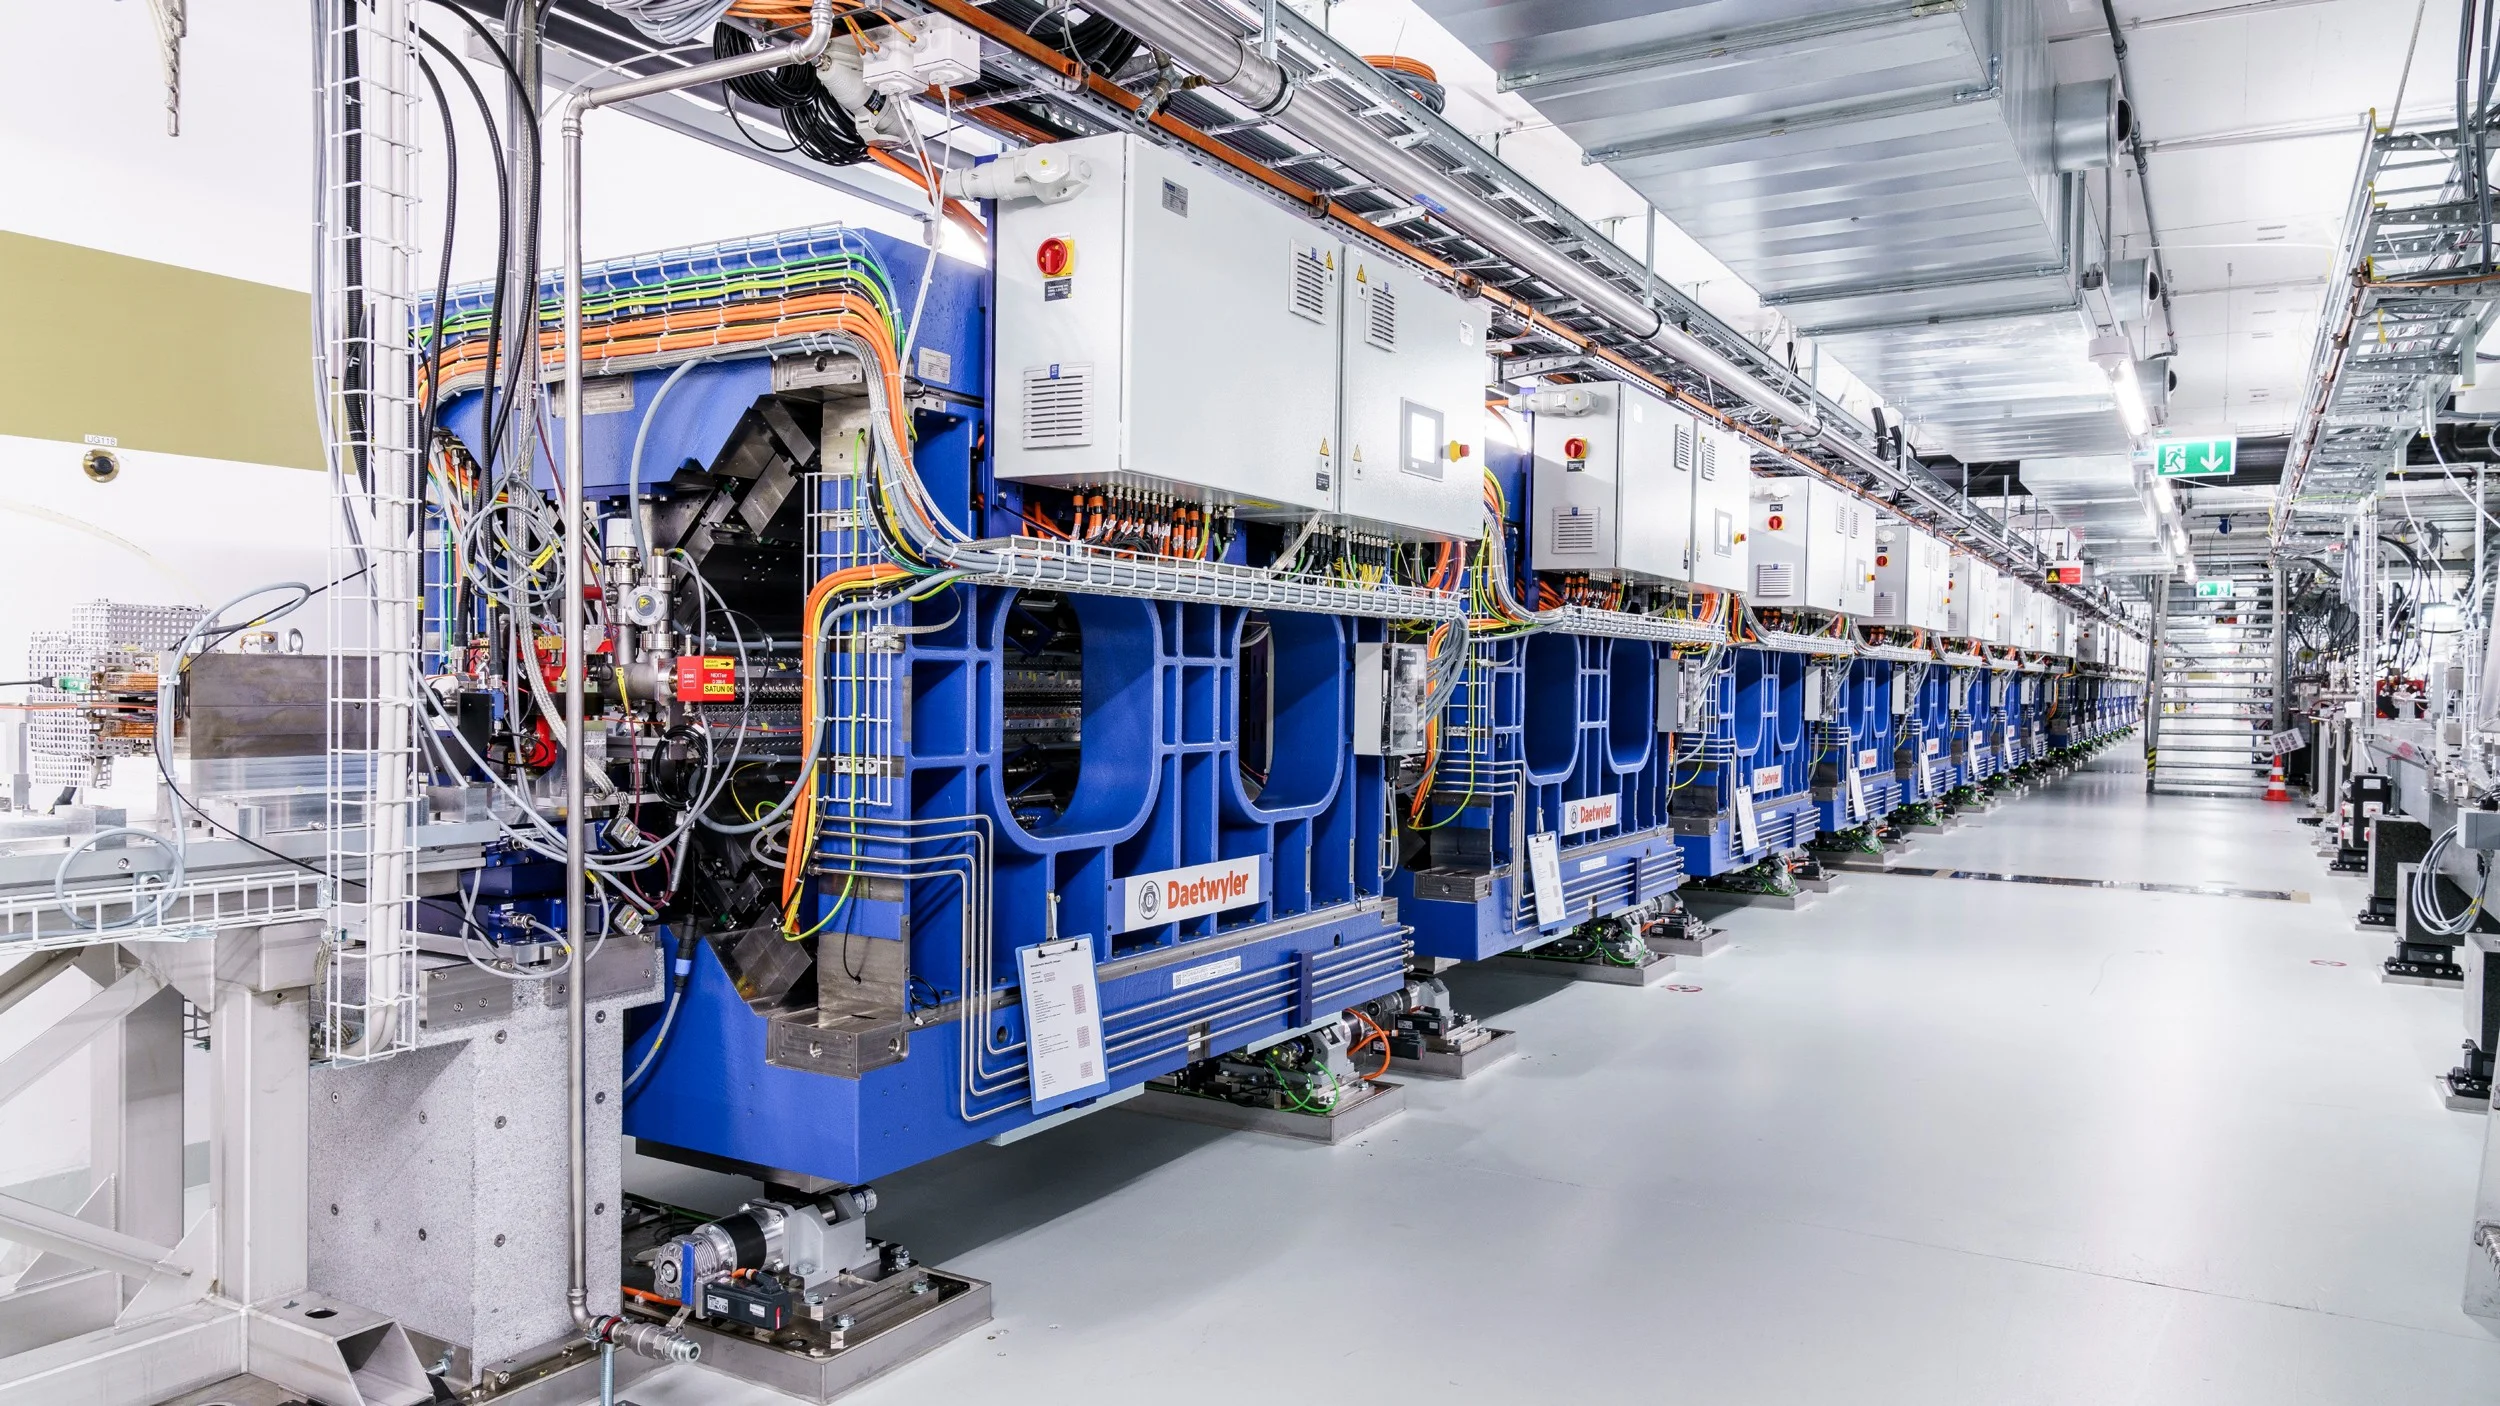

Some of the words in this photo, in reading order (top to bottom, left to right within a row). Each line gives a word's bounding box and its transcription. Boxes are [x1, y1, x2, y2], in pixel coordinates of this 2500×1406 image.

[87, 435, 116, 446] UG118
[704, 685, 726, 693] SATUN
[1580, 802, 1612, 824] Daetwyler
[1167, 870, 1249, 910] Daetwyler
